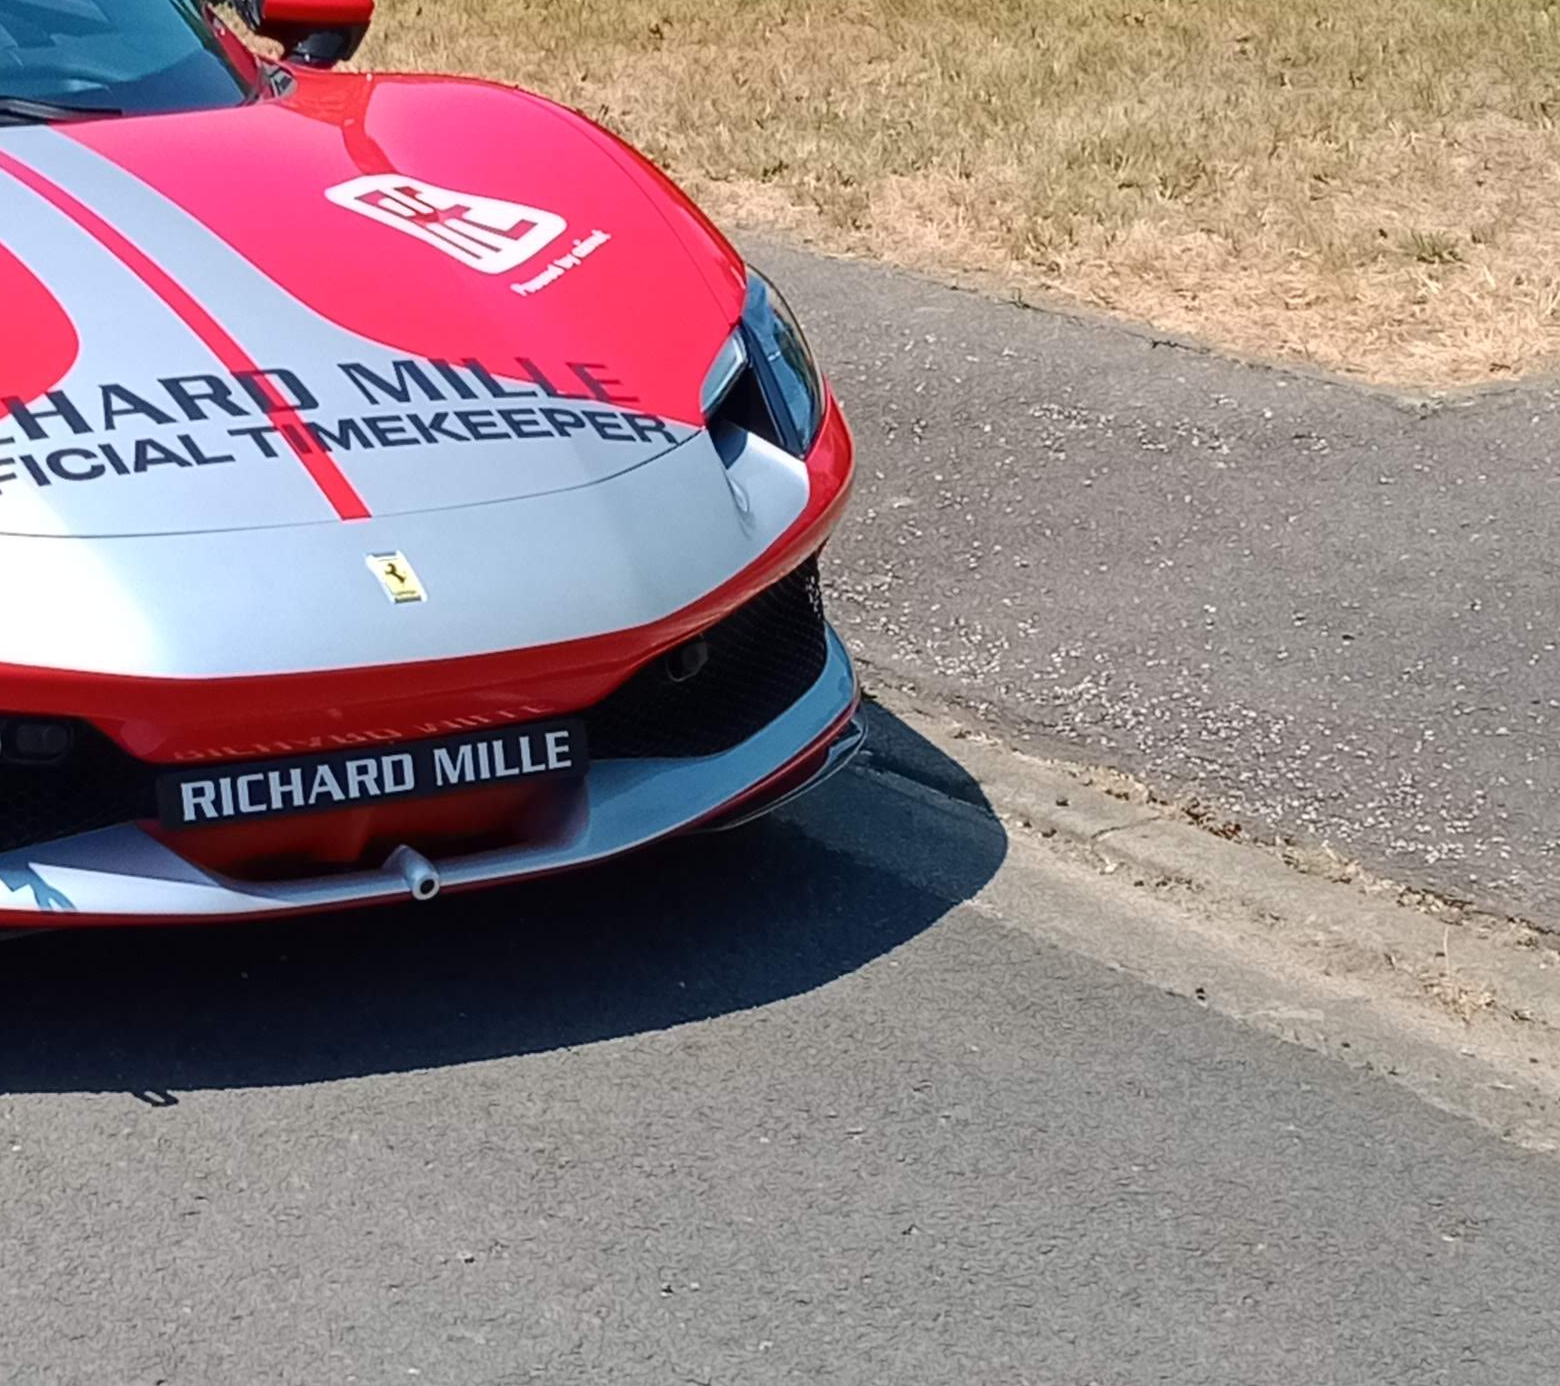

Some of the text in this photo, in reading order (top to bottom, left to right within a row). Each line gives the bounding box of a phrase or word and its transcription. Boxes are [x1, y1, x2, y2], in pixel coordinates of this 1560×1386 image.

[337, 356, 640, 406] MILLE
[227, 407, 681, 459] TIMEKEEPER
[180, 751, 416, 822] RICHARD
[433, 730, 572, 787] MILLE
